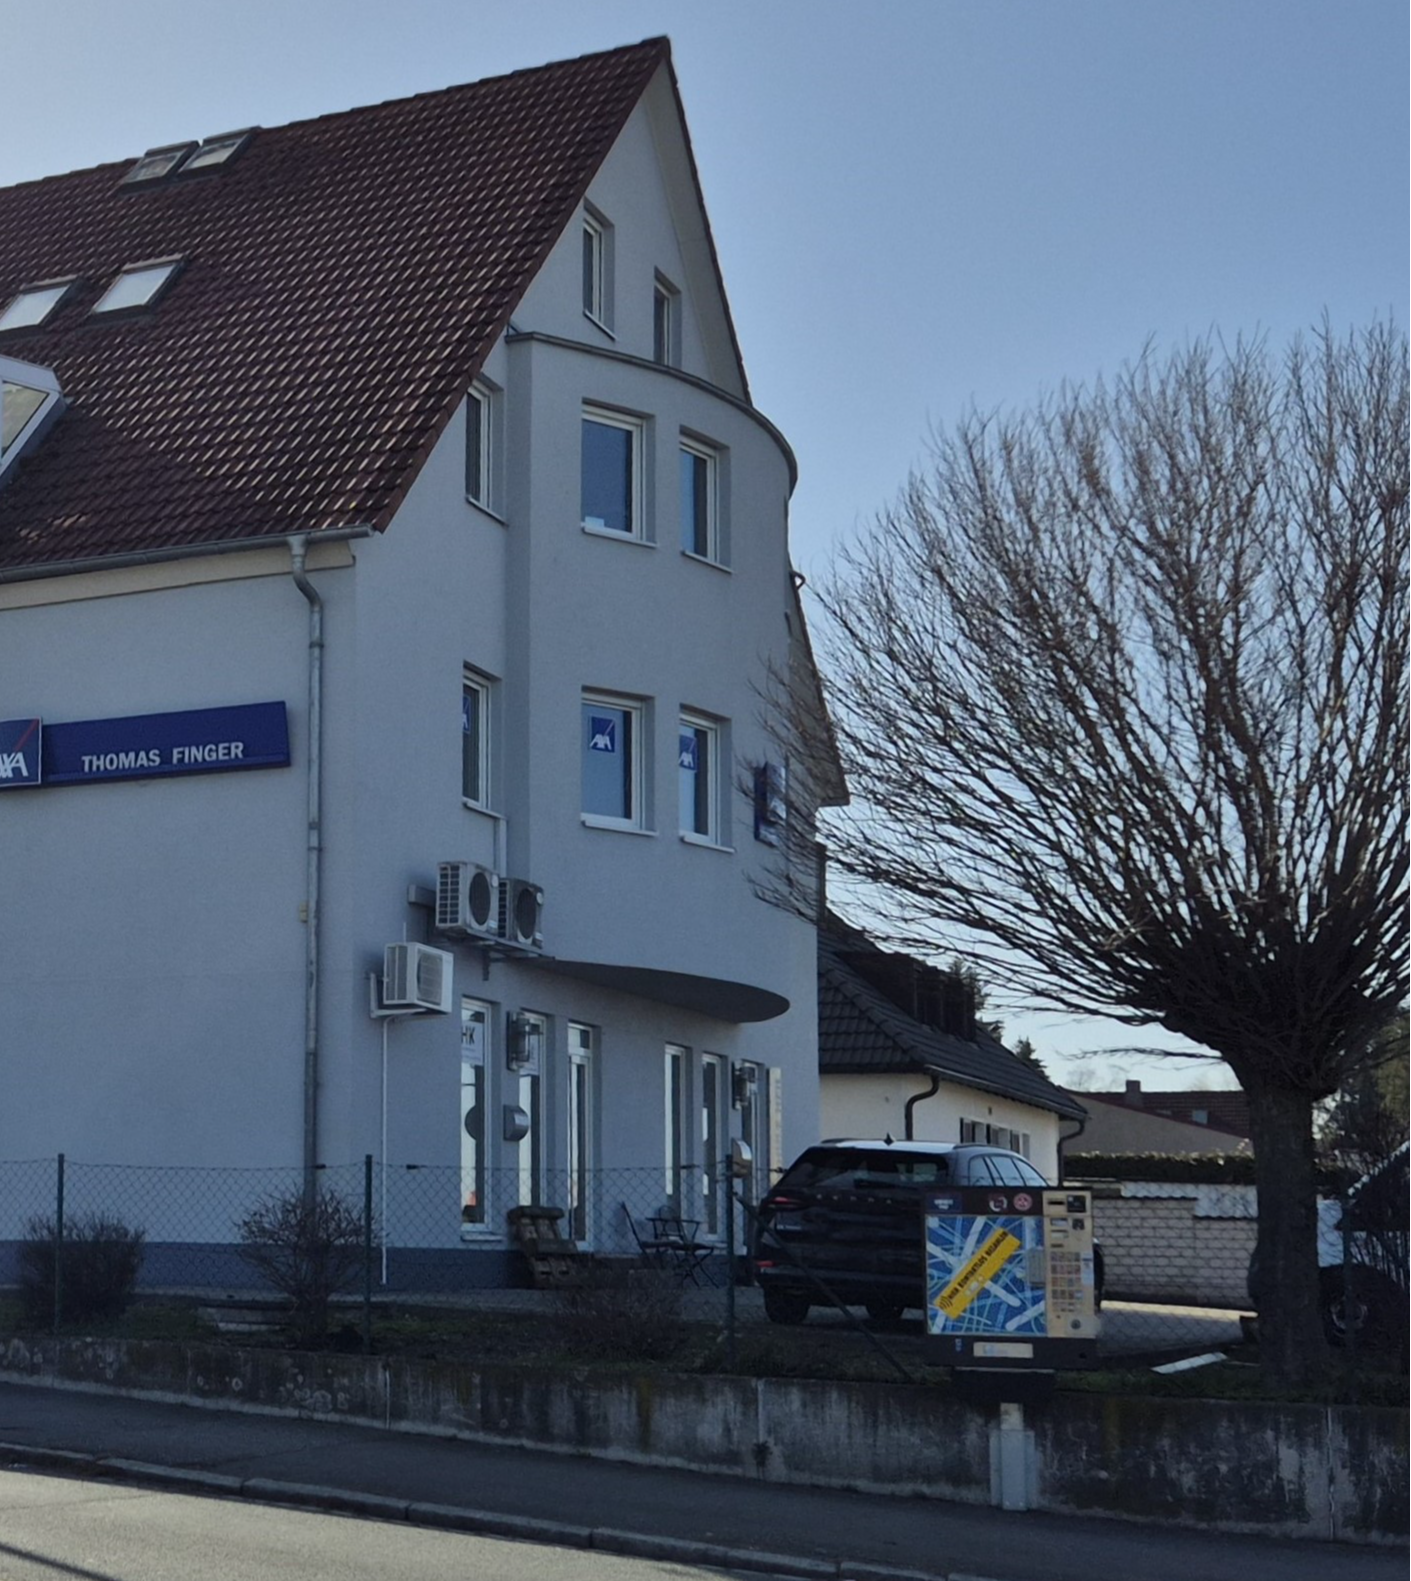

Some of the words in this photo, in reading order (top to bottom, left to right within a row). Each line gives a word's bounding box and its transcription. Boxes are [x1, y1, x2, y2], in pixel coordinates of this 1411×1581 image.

[589, 734, 612, 751] AXA
[81, 748, 161, 773] THOMAS
[171, 741, 244, 765] FINGER
